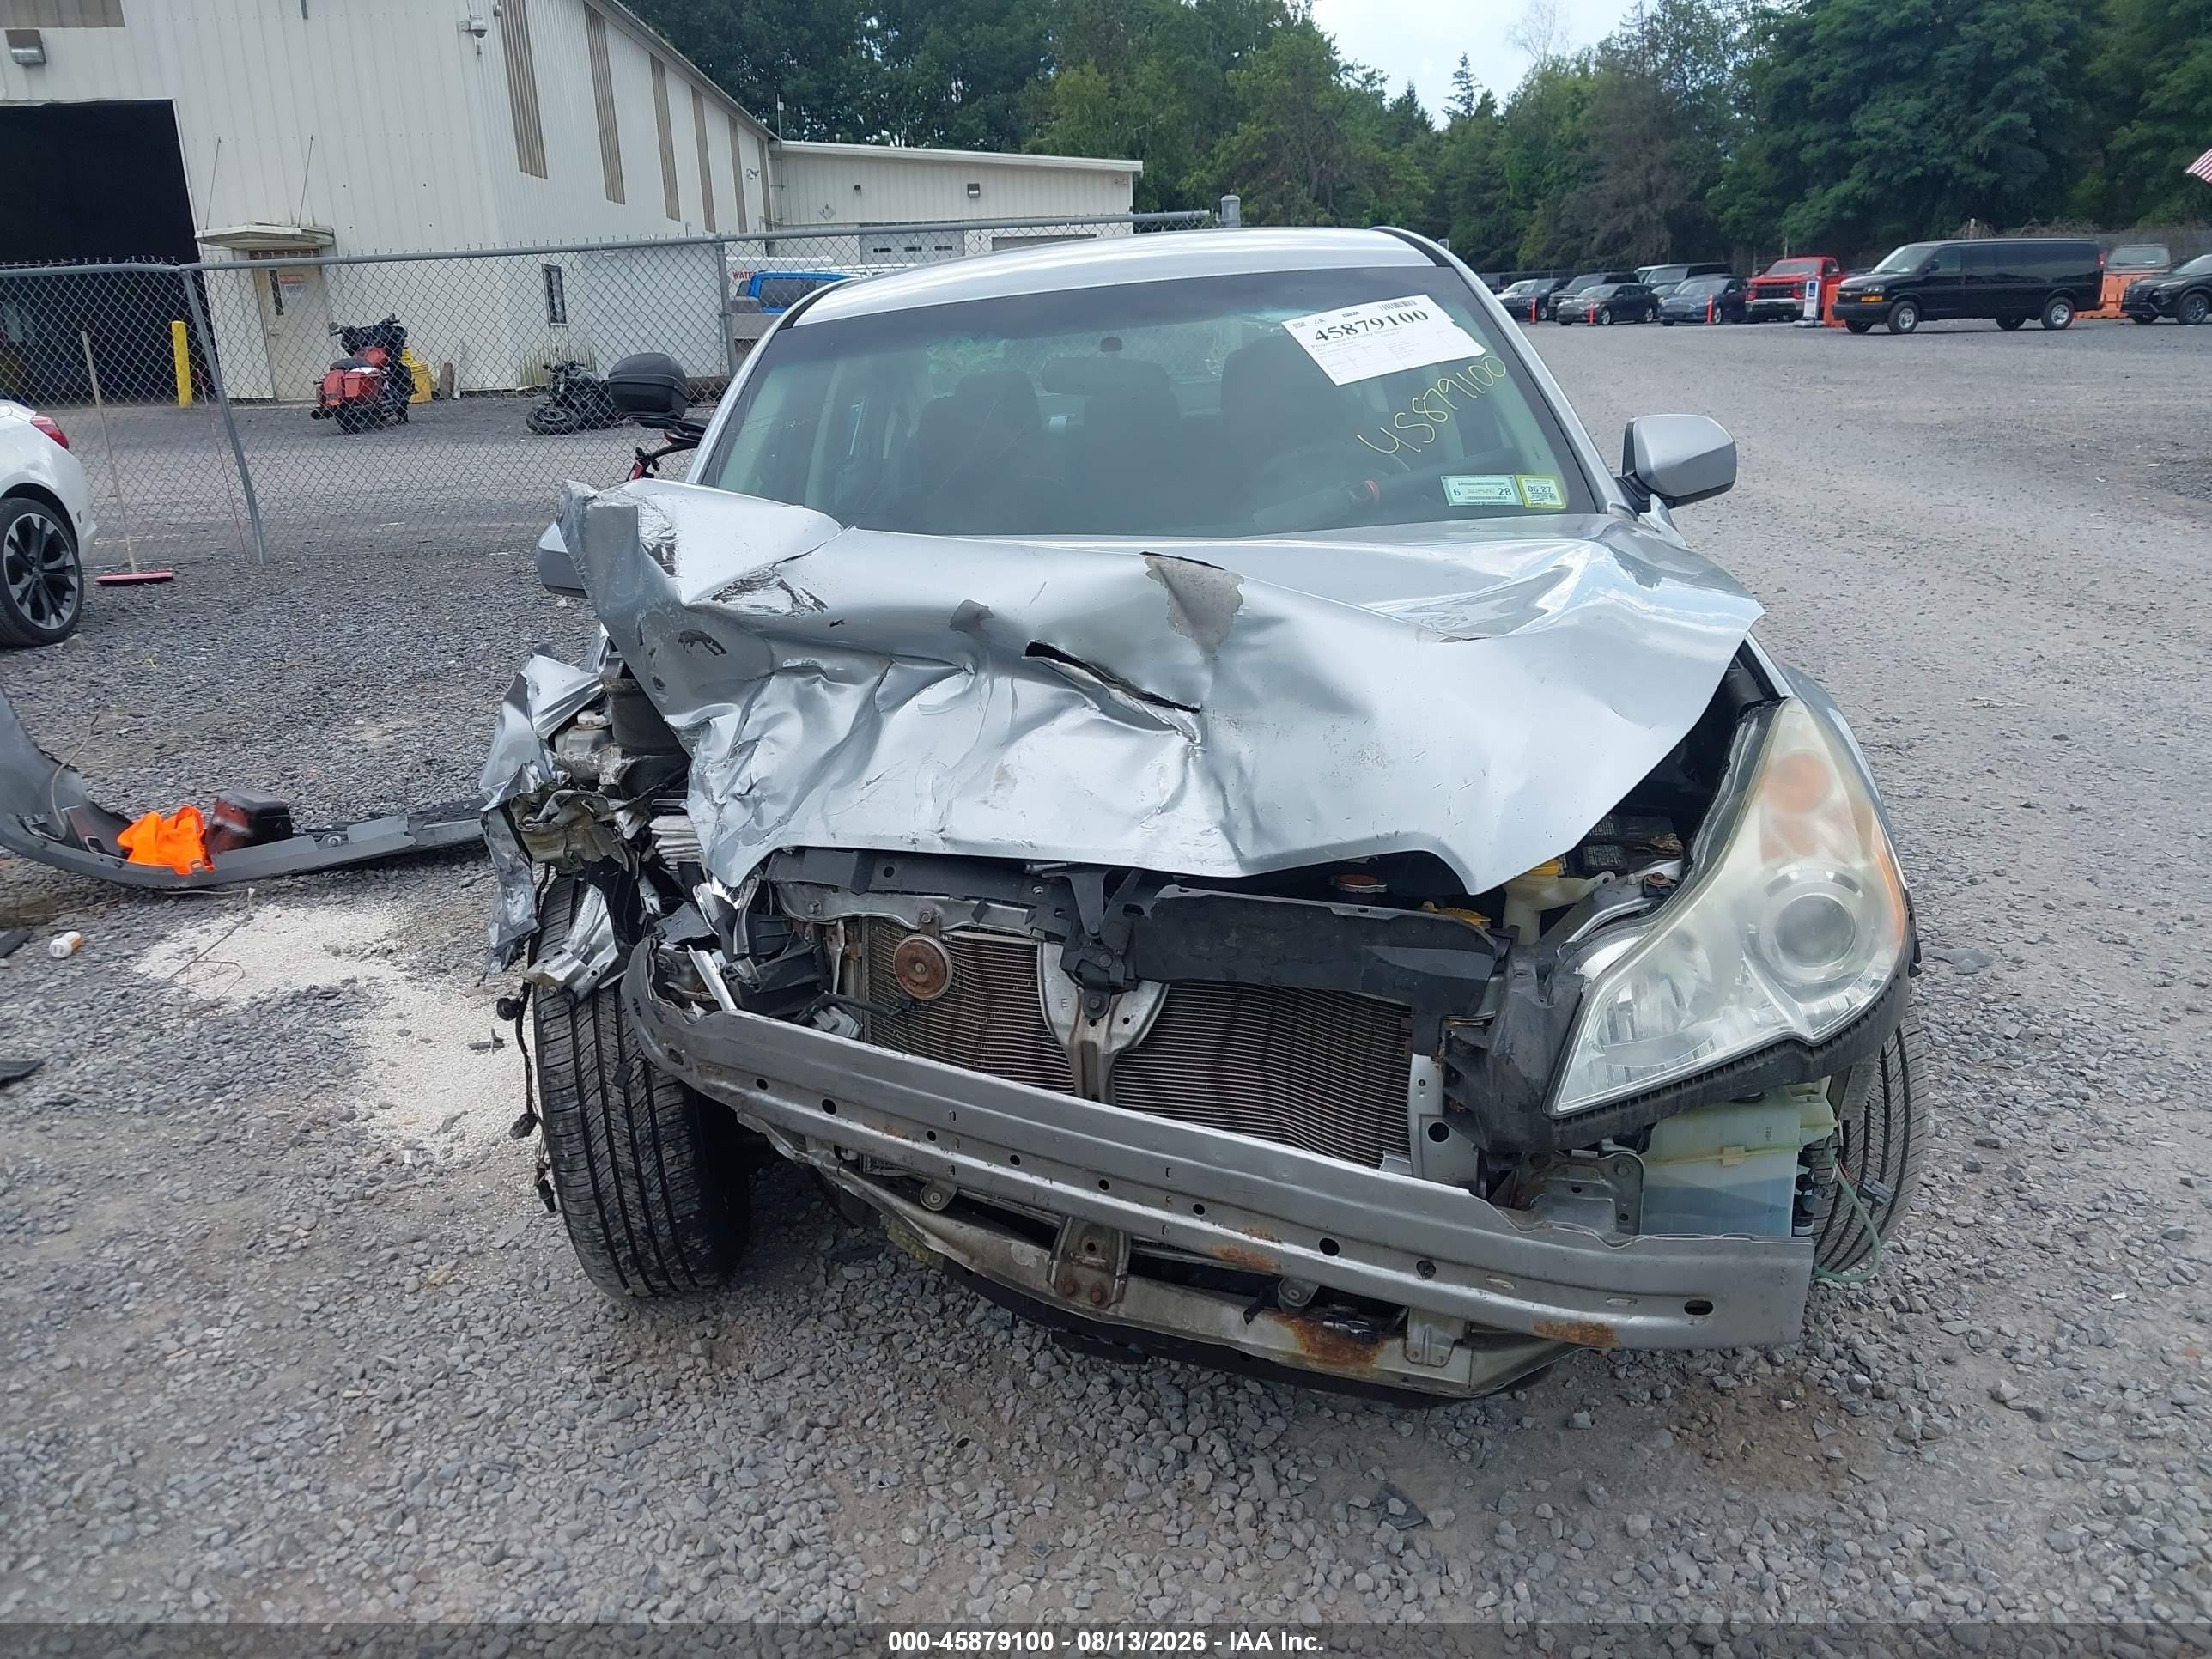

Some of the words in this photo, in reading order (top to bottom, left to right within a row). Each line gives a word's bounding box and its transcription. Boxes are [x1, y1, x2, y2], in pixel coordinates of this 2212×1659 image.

[1315, 309, 1429, 342] 45879100
[1357, 356, 1506, 453] 45879100
[1453, 488, 1461, 496] 6
[1497, 487, 1511, 496] 28
